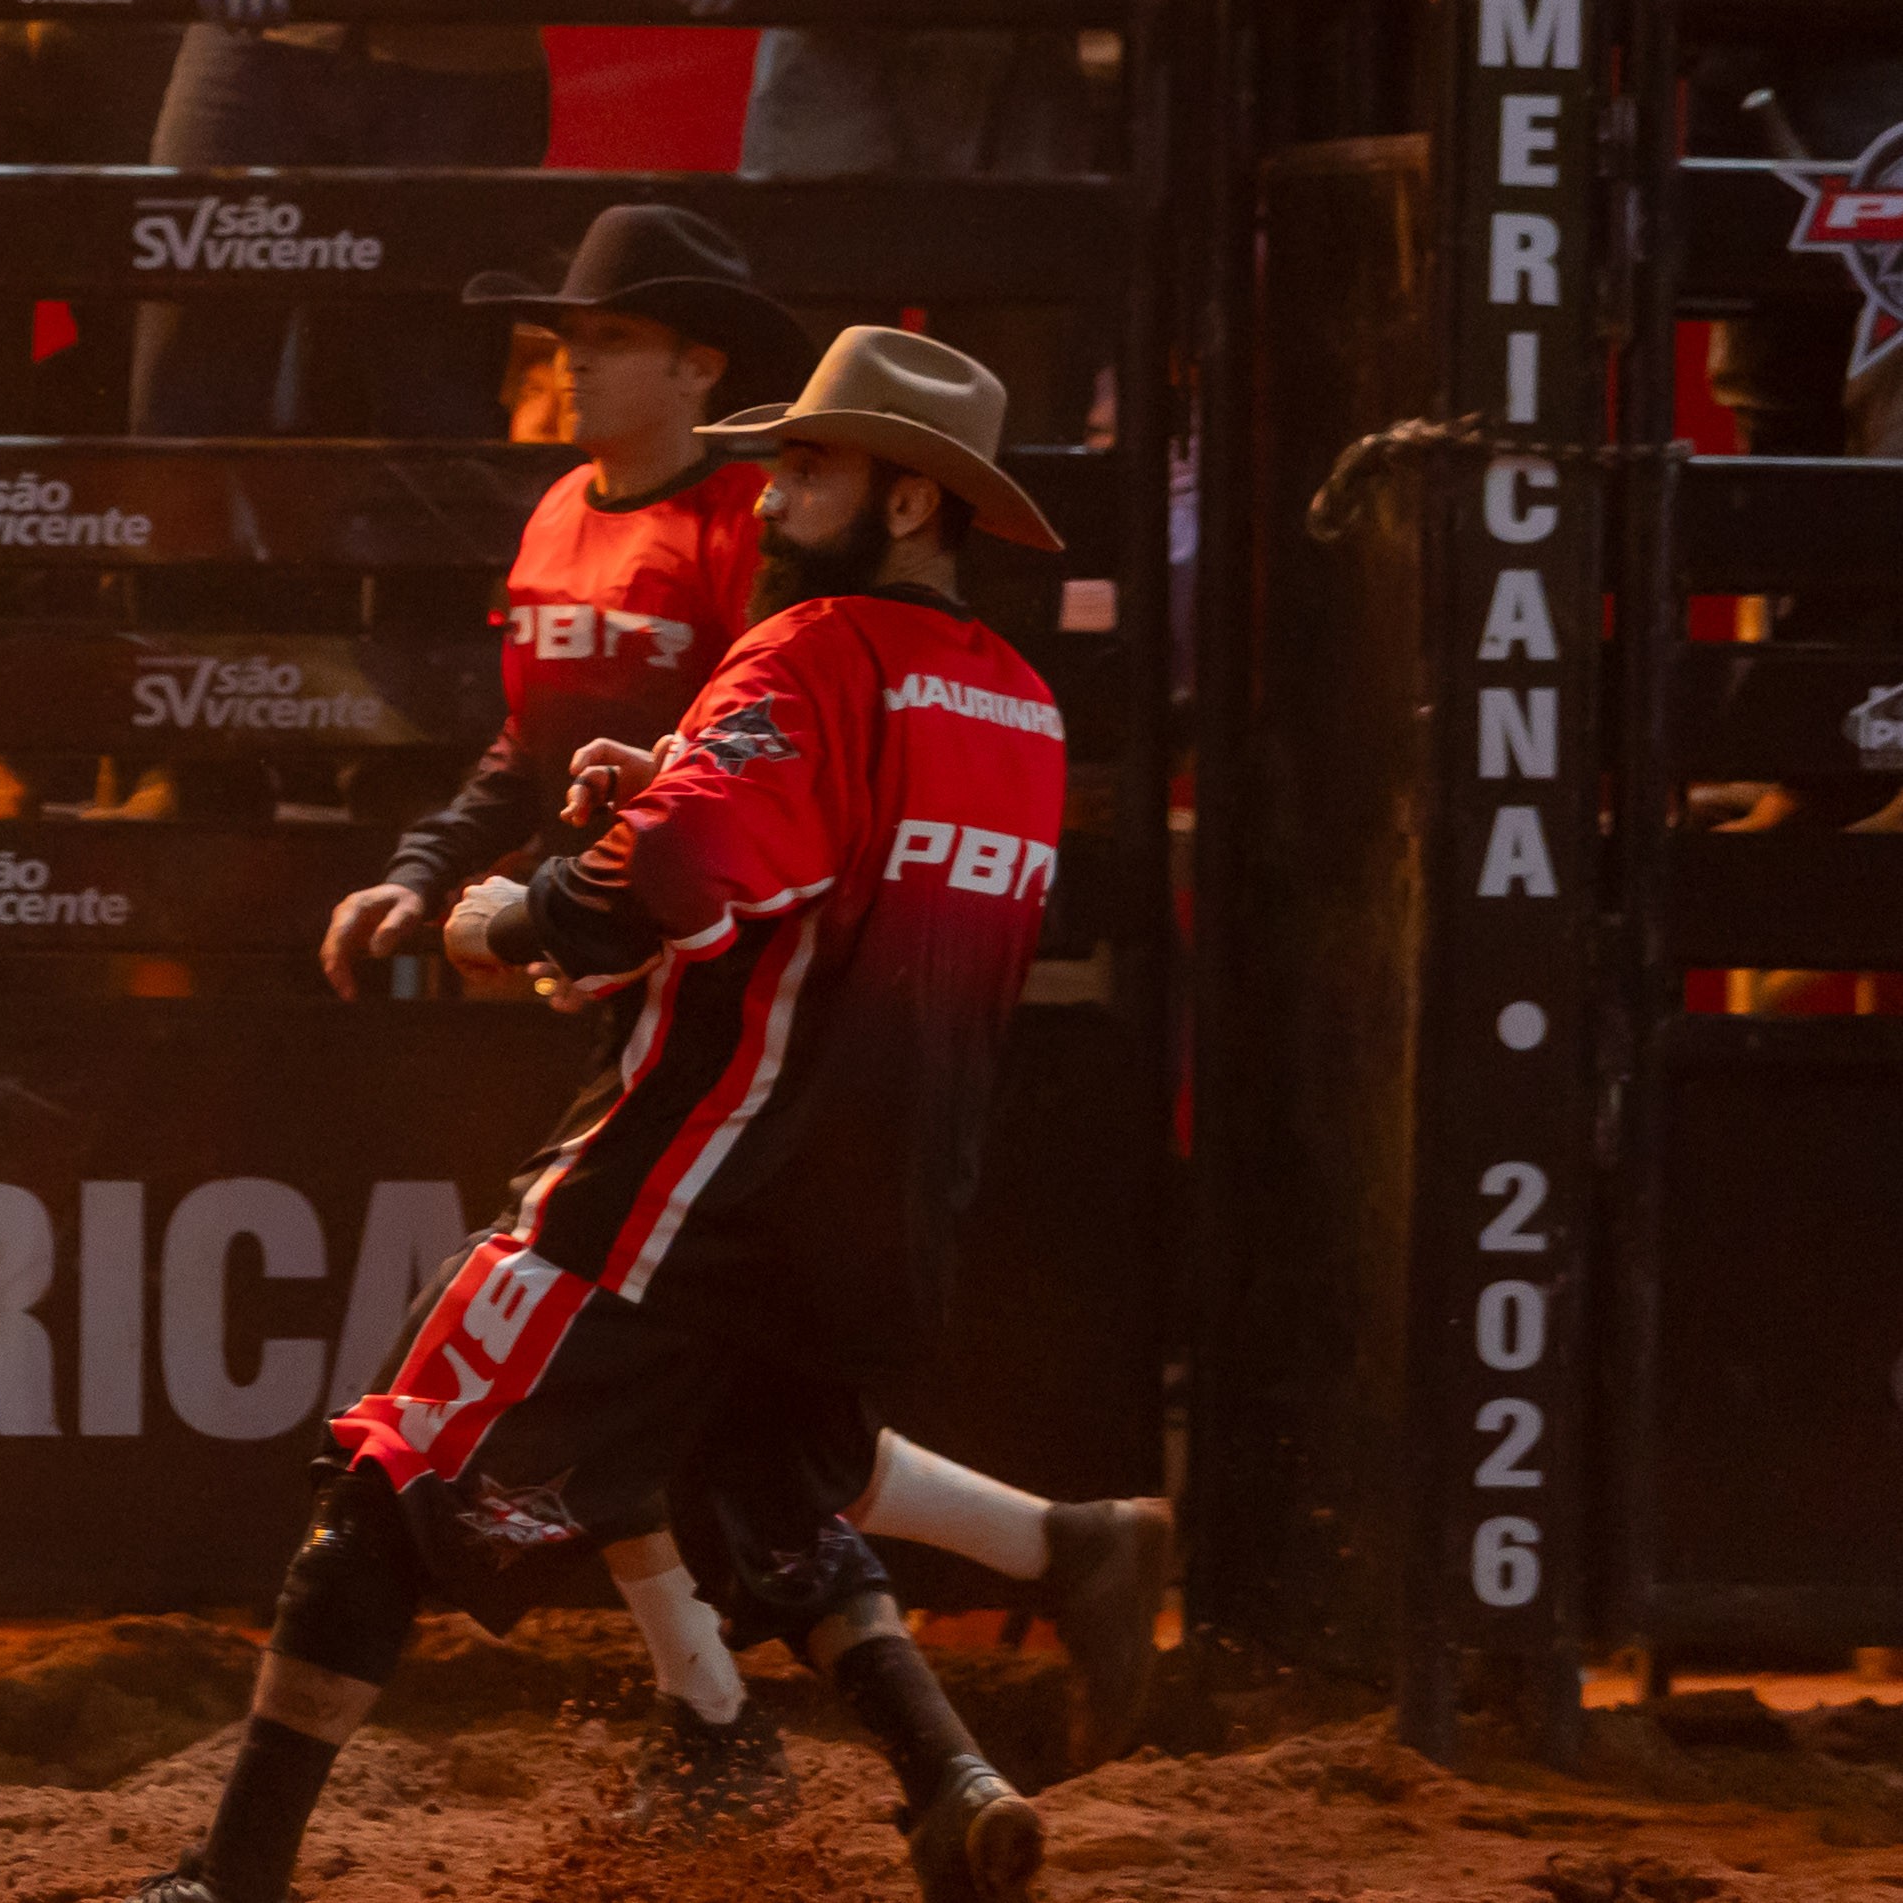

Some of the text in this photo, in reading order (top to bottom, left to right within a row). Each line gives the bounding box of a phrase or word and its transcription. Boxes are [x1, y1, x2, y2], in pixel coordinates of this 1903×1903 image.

[213, 198, 302, 235] são
[202, 229, 383, 272] vicente
[1470, 1161, 1549, 1609] 2026
